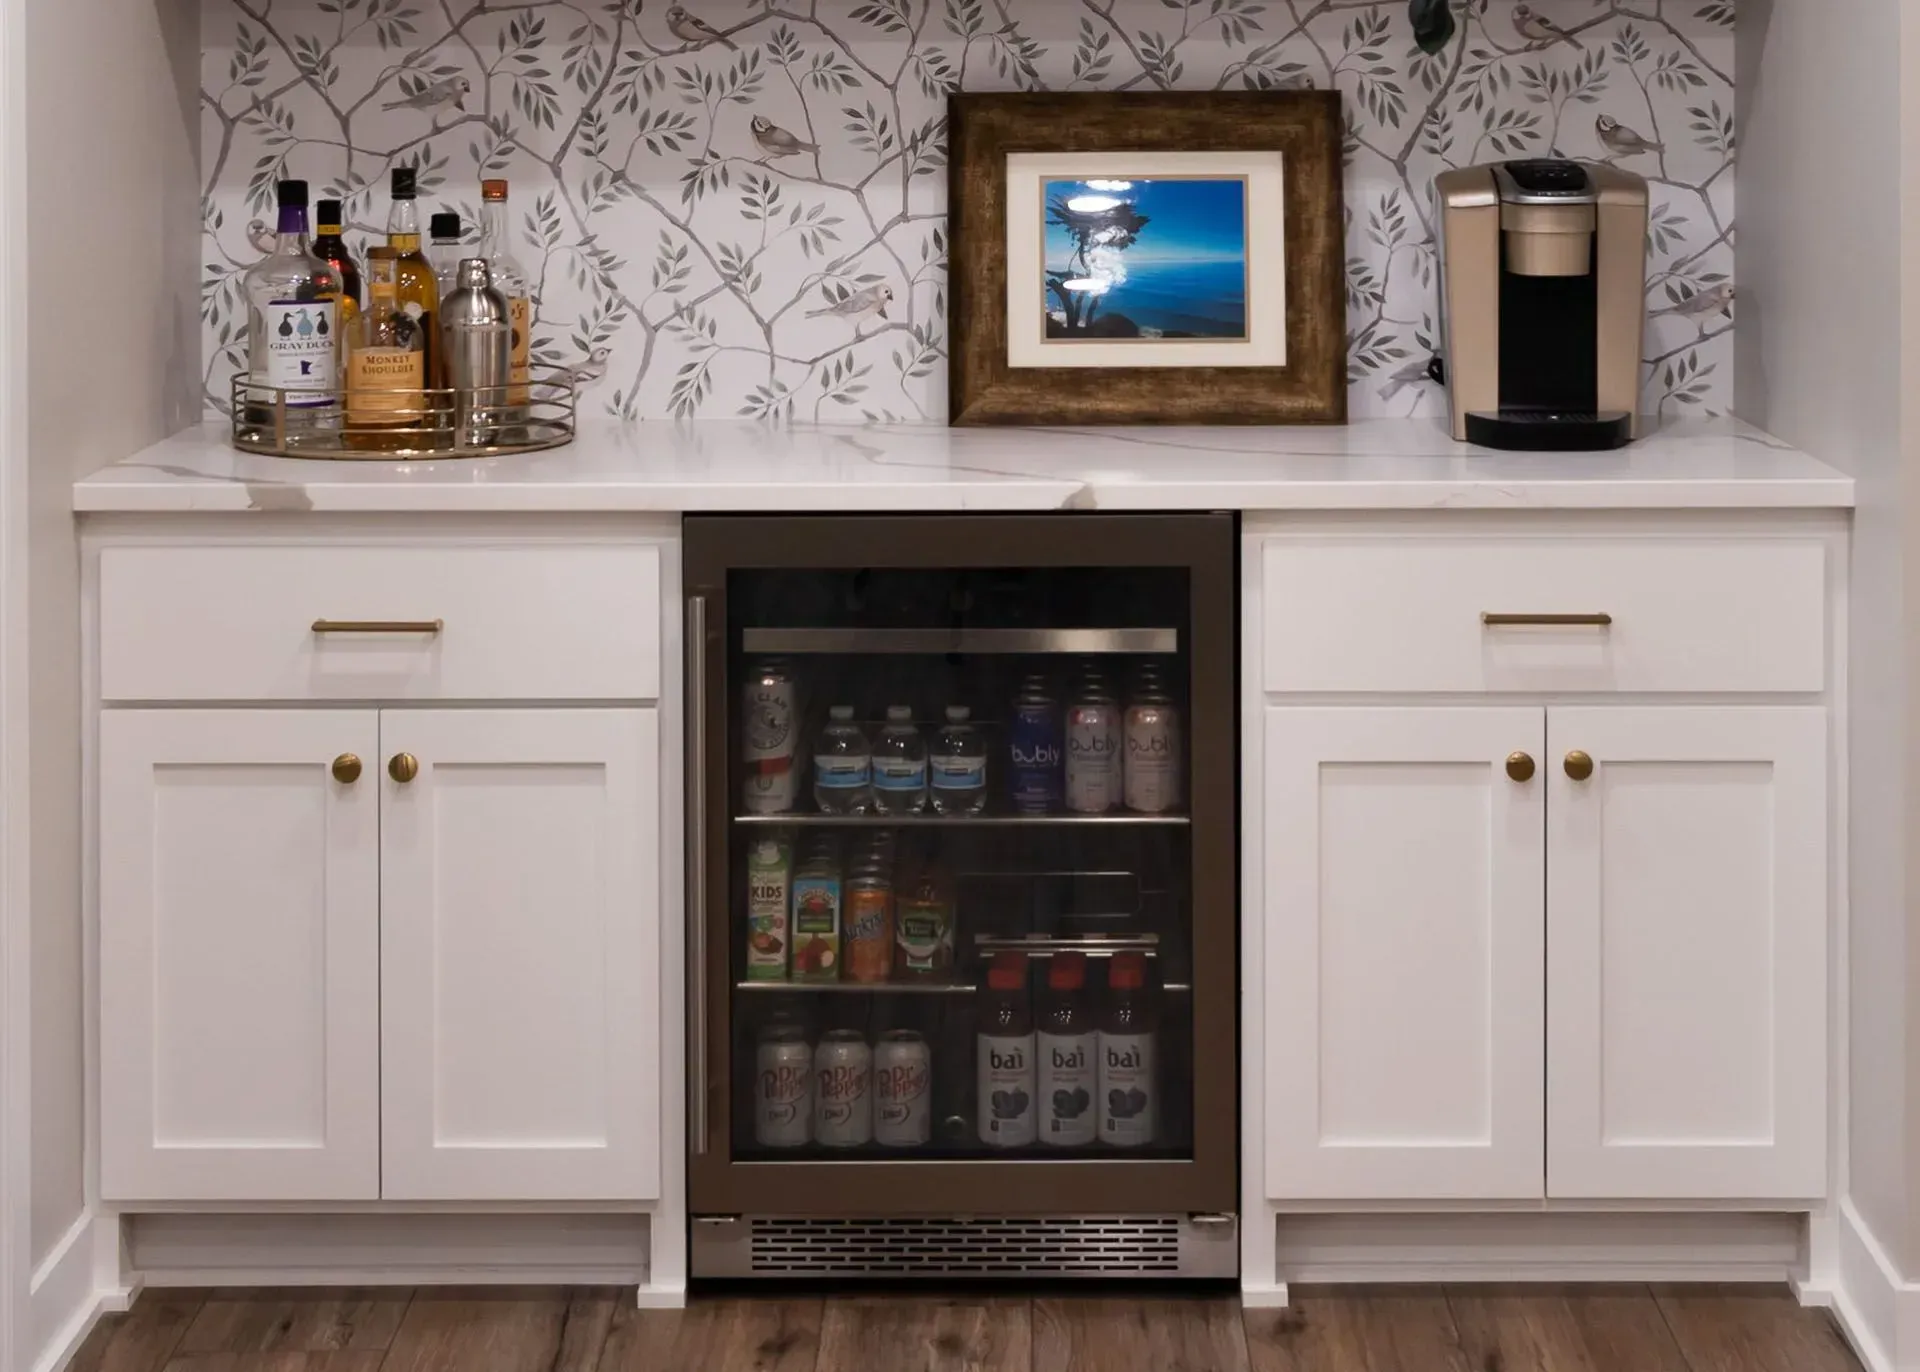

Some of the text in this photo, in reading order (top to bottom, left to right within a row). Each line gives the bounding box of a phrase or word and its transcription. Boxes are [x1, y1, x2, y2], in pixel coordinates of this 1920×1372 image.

[270, 341, 303, 350] GRAY
[365, 355, 410, 365] MONKEY
[361, 364, 415, 376] SHOULDER
[1069, 734, 1117, 756] bubly
[1010, 743, 1061, 766] bubly
[751, 886, 783, 899] KIDS
